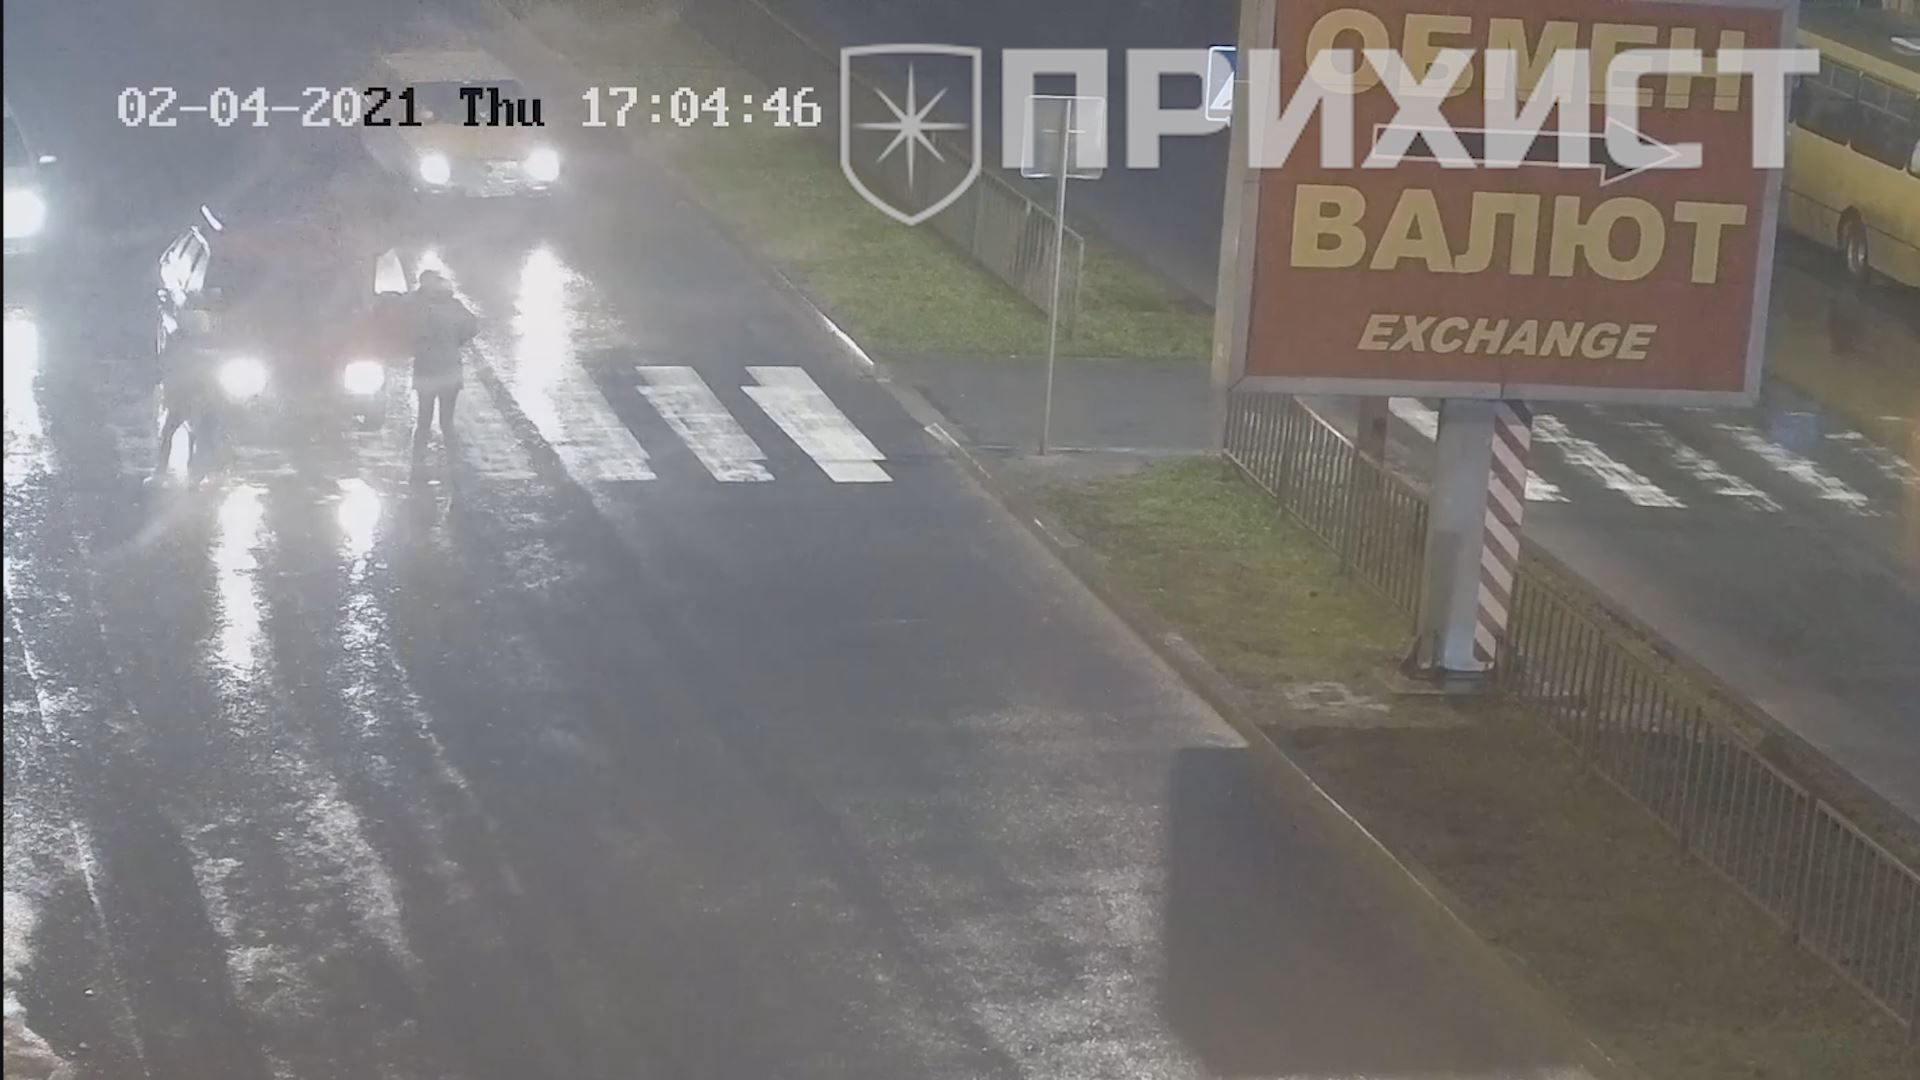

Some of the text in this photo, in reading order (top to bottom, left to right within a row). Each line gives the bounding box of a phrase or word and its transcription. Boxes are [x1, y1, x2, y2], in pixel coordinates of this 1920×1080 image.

[1305, 8, 1746, 111] ОБМЕН
[1290, 184, 1748, 285] ВАЛЮТ
[1357, 313, 1657, 361] EXCHANGE
